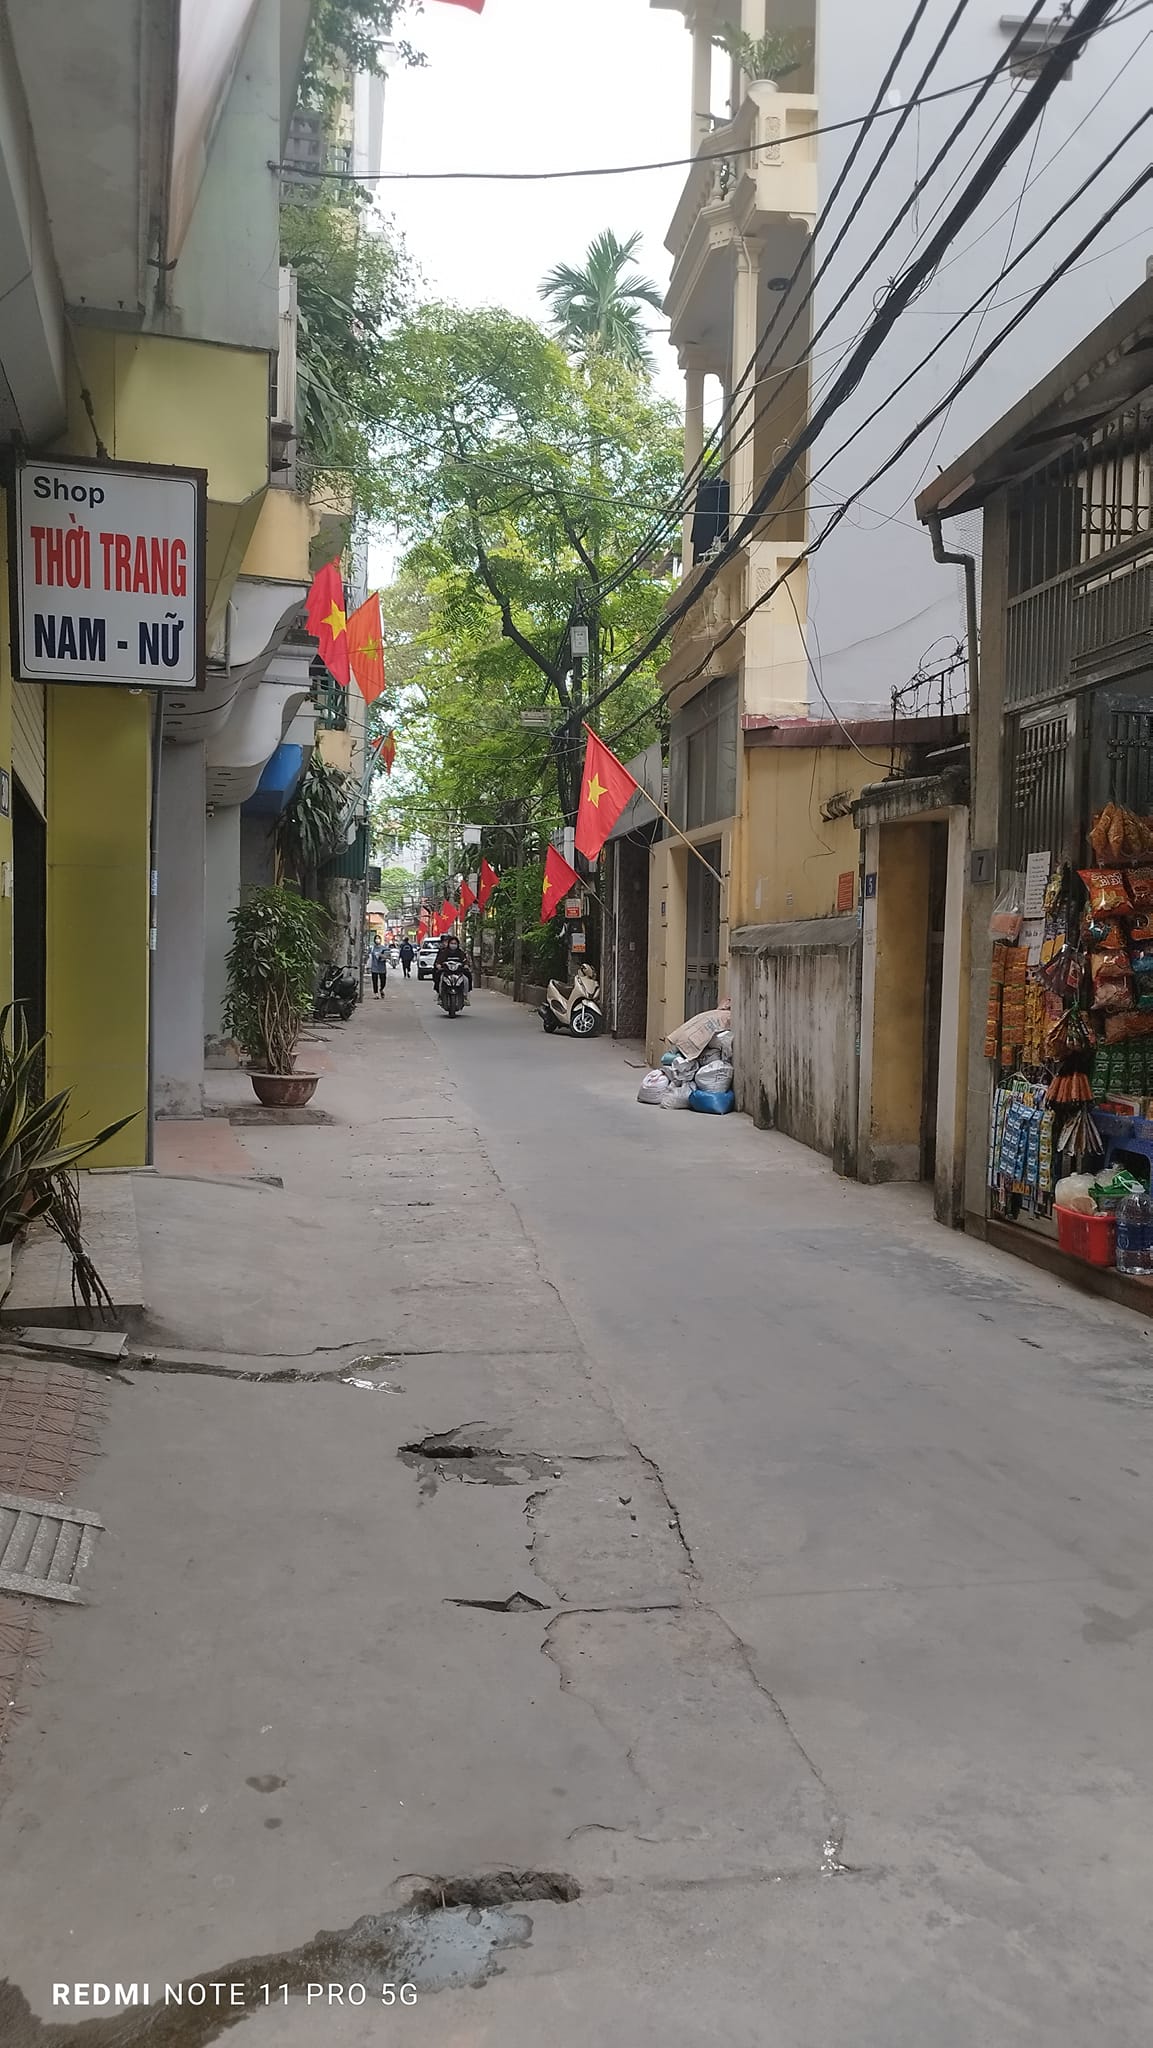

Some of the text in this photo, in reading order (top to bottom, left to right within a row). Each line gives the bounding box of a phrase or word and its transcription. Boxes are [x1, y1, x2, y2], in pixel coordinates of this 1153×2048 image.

[33, 475, 105, 508] Shop
[30, 513, 186, 597] THỜI TRANG
[34, 612, 184, 667] NAM - NỮ
[977, 856, 984, 876] 7
[868, 877, 873, 894] 5
